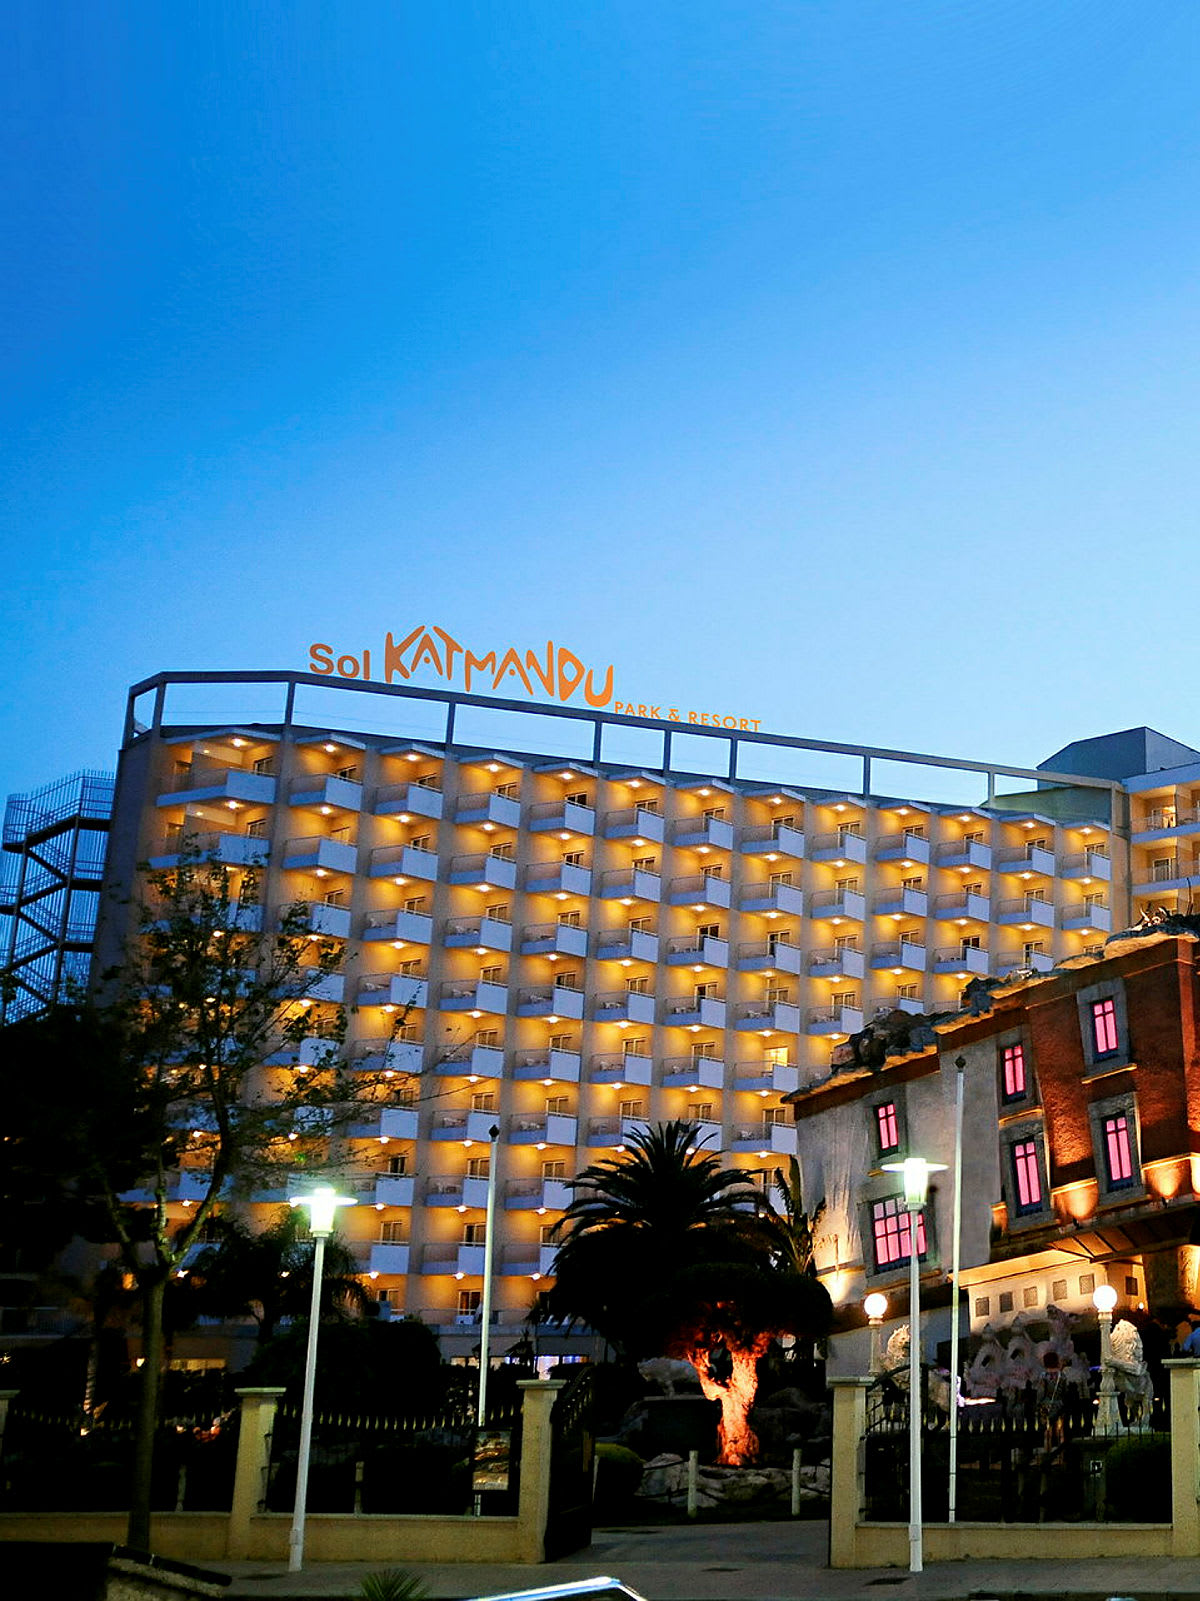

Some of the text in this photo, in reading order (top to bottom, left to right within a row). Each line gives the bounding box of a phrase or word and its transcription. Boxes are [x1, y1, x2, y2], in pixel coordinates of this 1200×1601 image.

[309, 625, 761, 732] Sol KATMANDU PARK & RESORT
